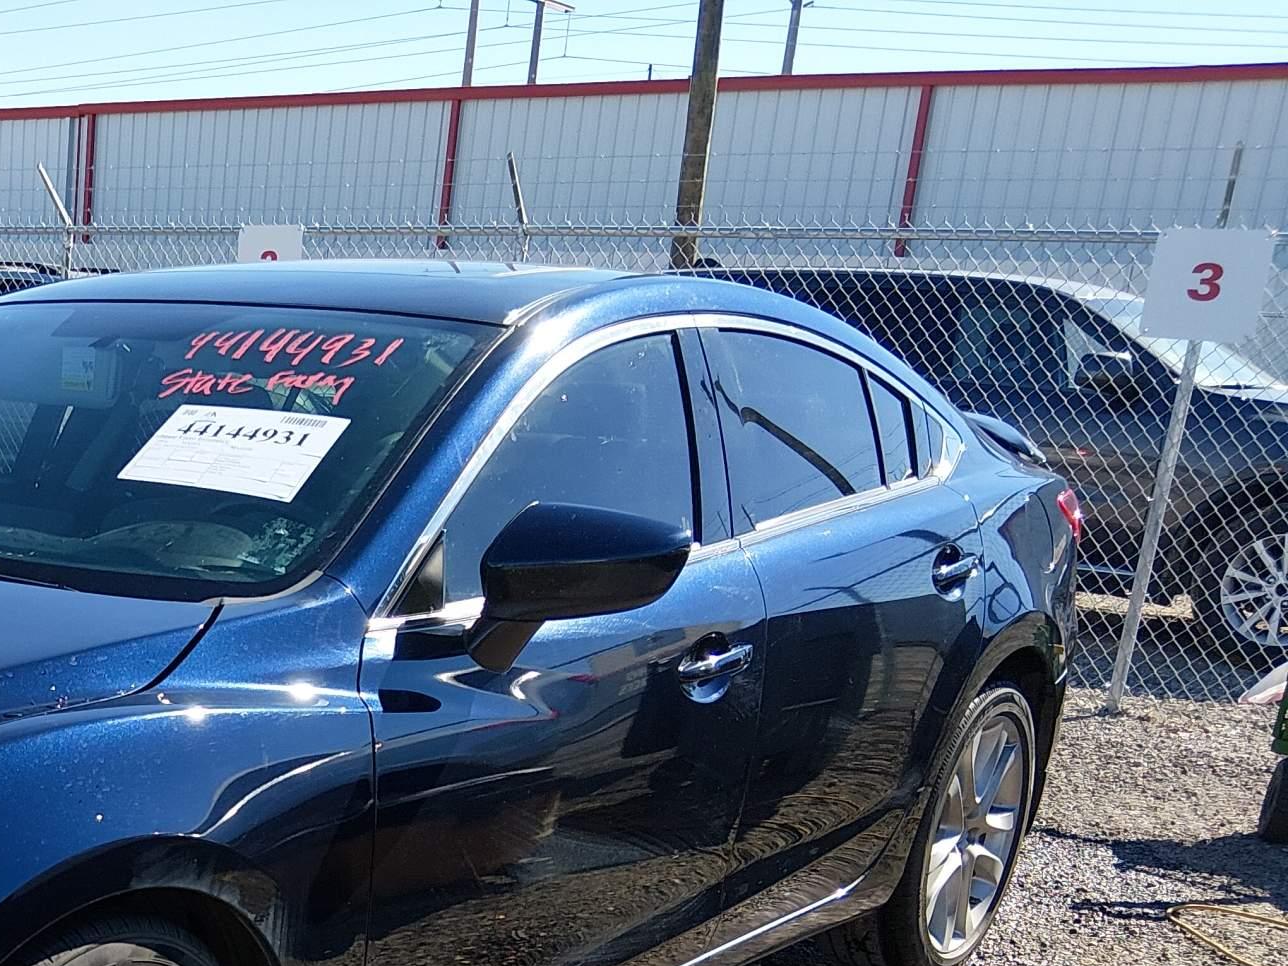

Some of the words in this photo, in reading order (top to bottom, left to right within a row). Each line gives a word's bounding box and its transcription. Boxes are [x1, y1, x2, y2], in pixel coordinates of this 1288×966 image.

[1187, 262, 1224, 302] 3
[184, 328, 404, 368] 44144931
[158, 367, 253, 399] State
[177, 421, 311, 447] 44144931
